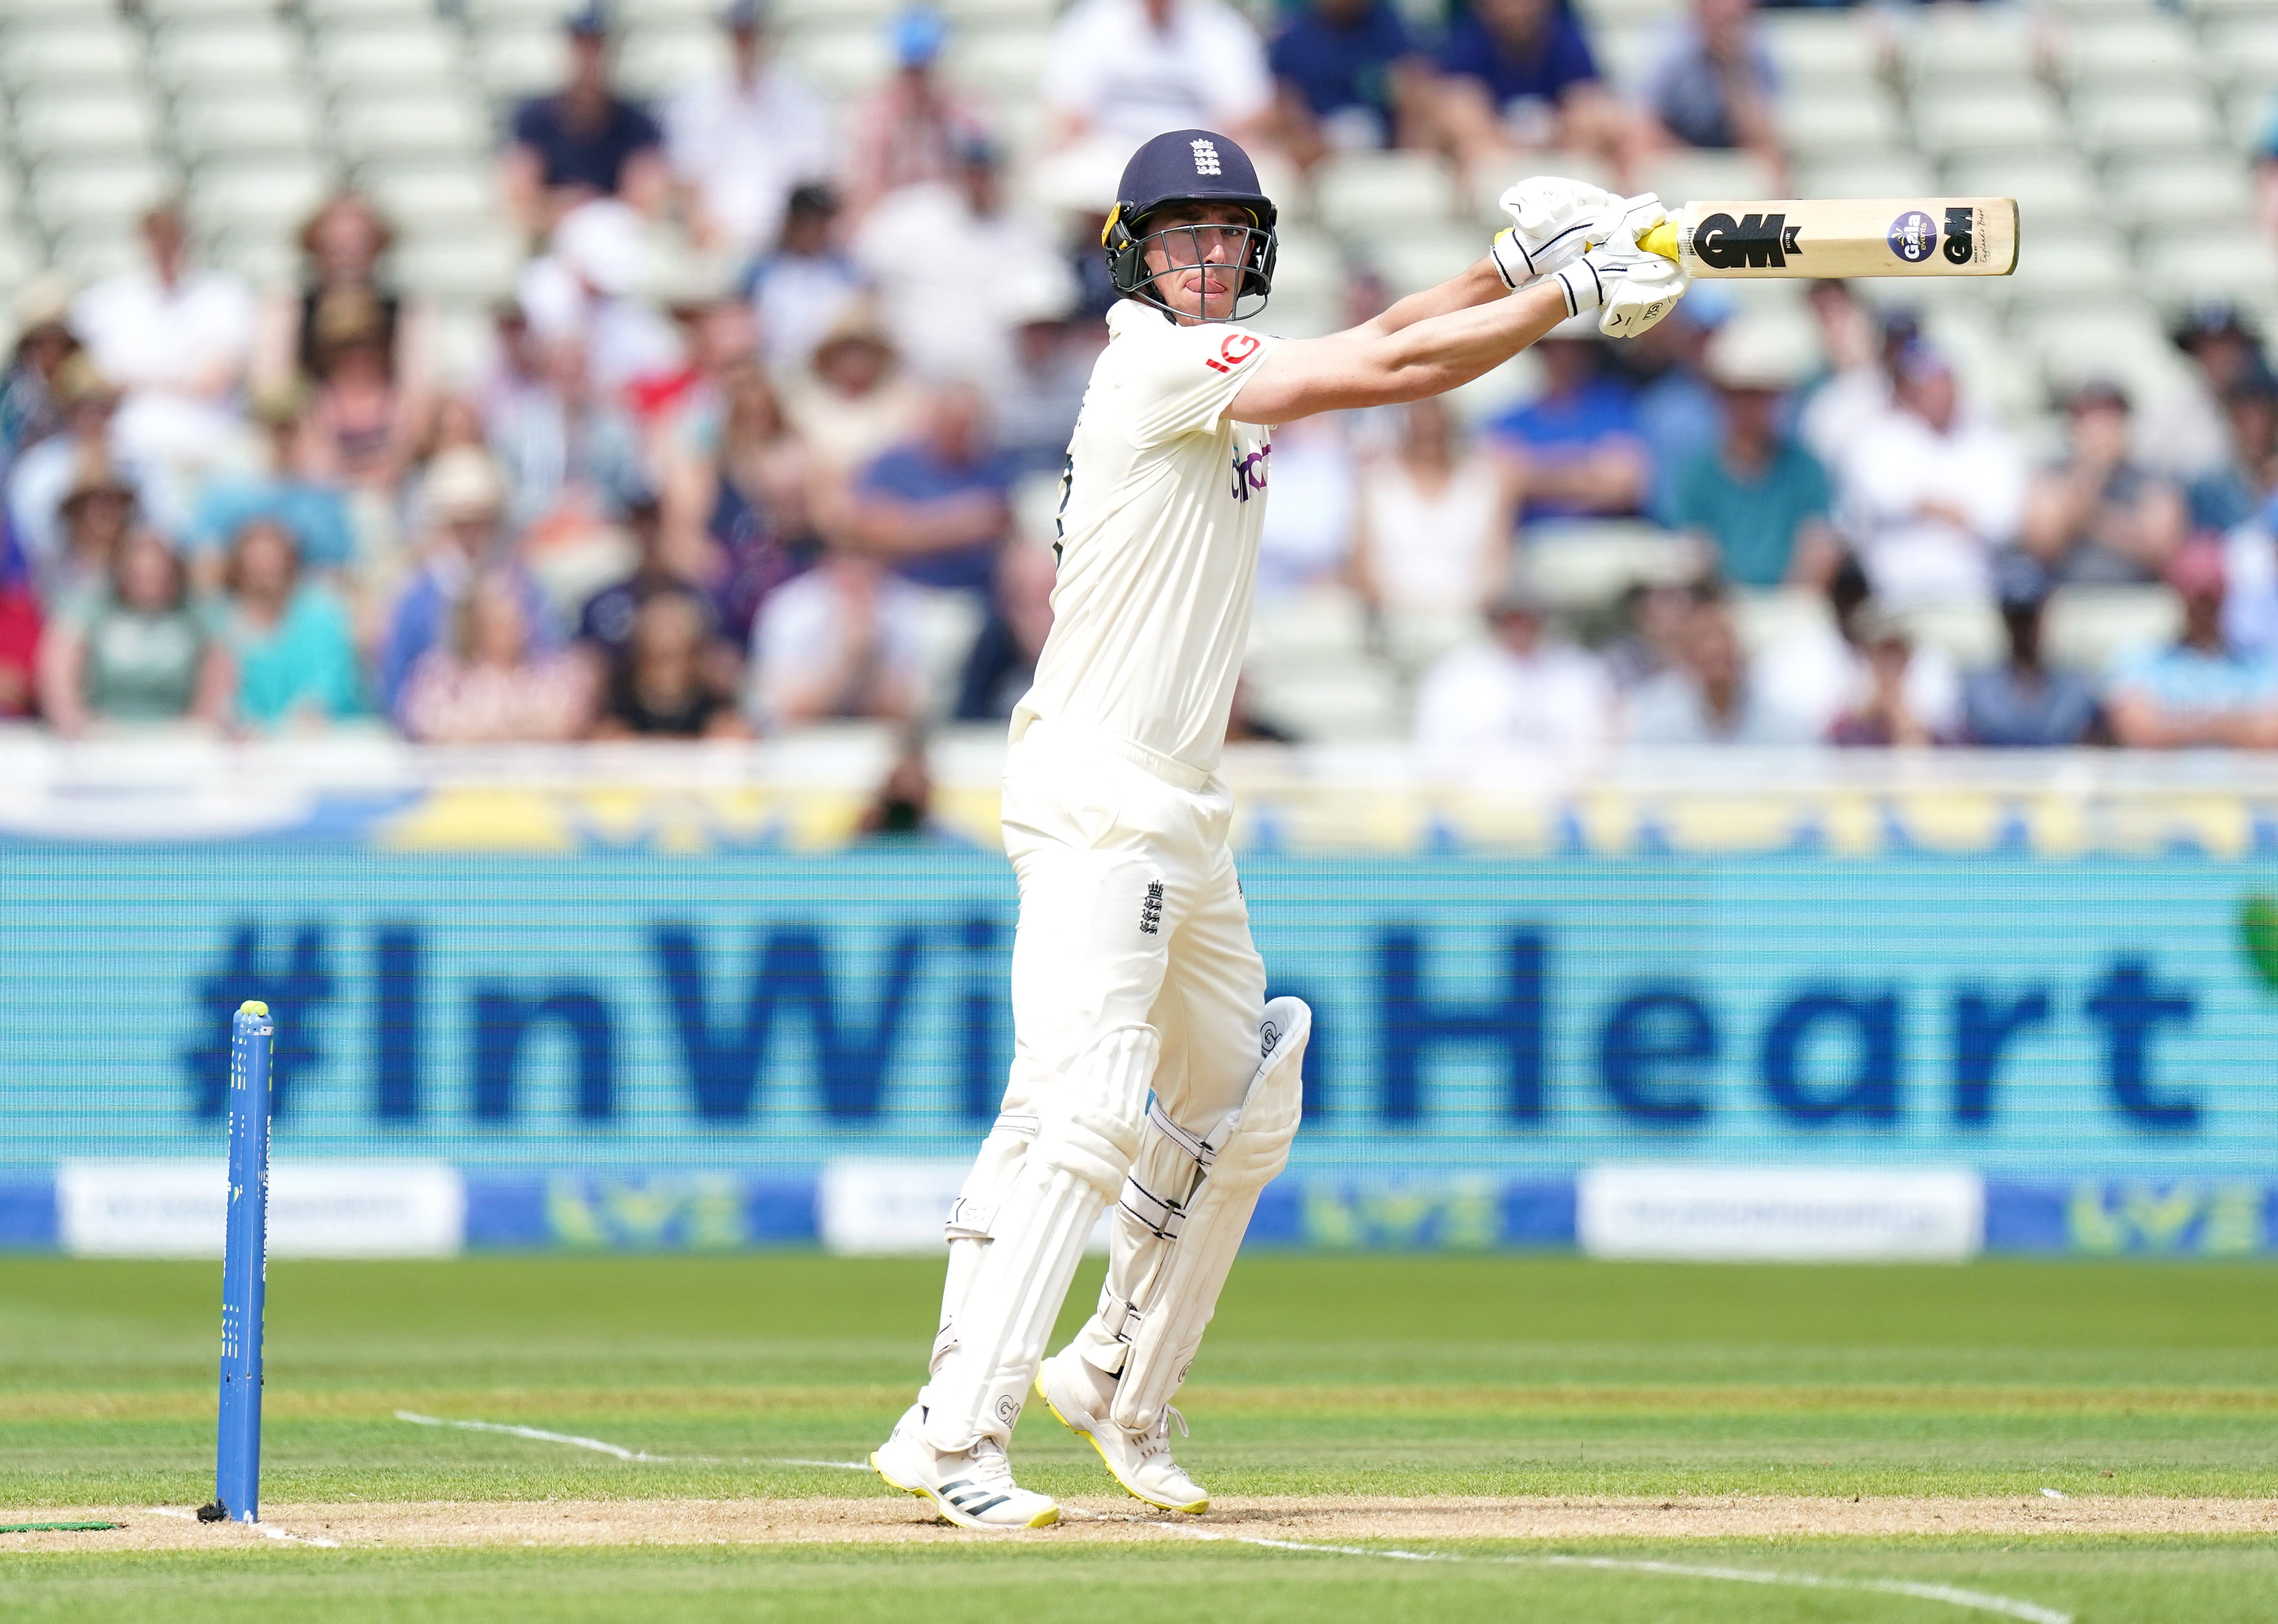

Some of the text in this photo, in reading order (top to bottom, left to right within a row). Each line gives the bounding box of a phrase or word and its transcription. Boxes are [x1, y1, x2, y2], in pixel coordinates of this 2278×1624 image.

[1693, 213, 1786, 269] GM
[1943, 207, 1973, 265] GM
[1205, 334, 1260, 373] IG
[184, 921, 2202, 1130] #InWiHeart
